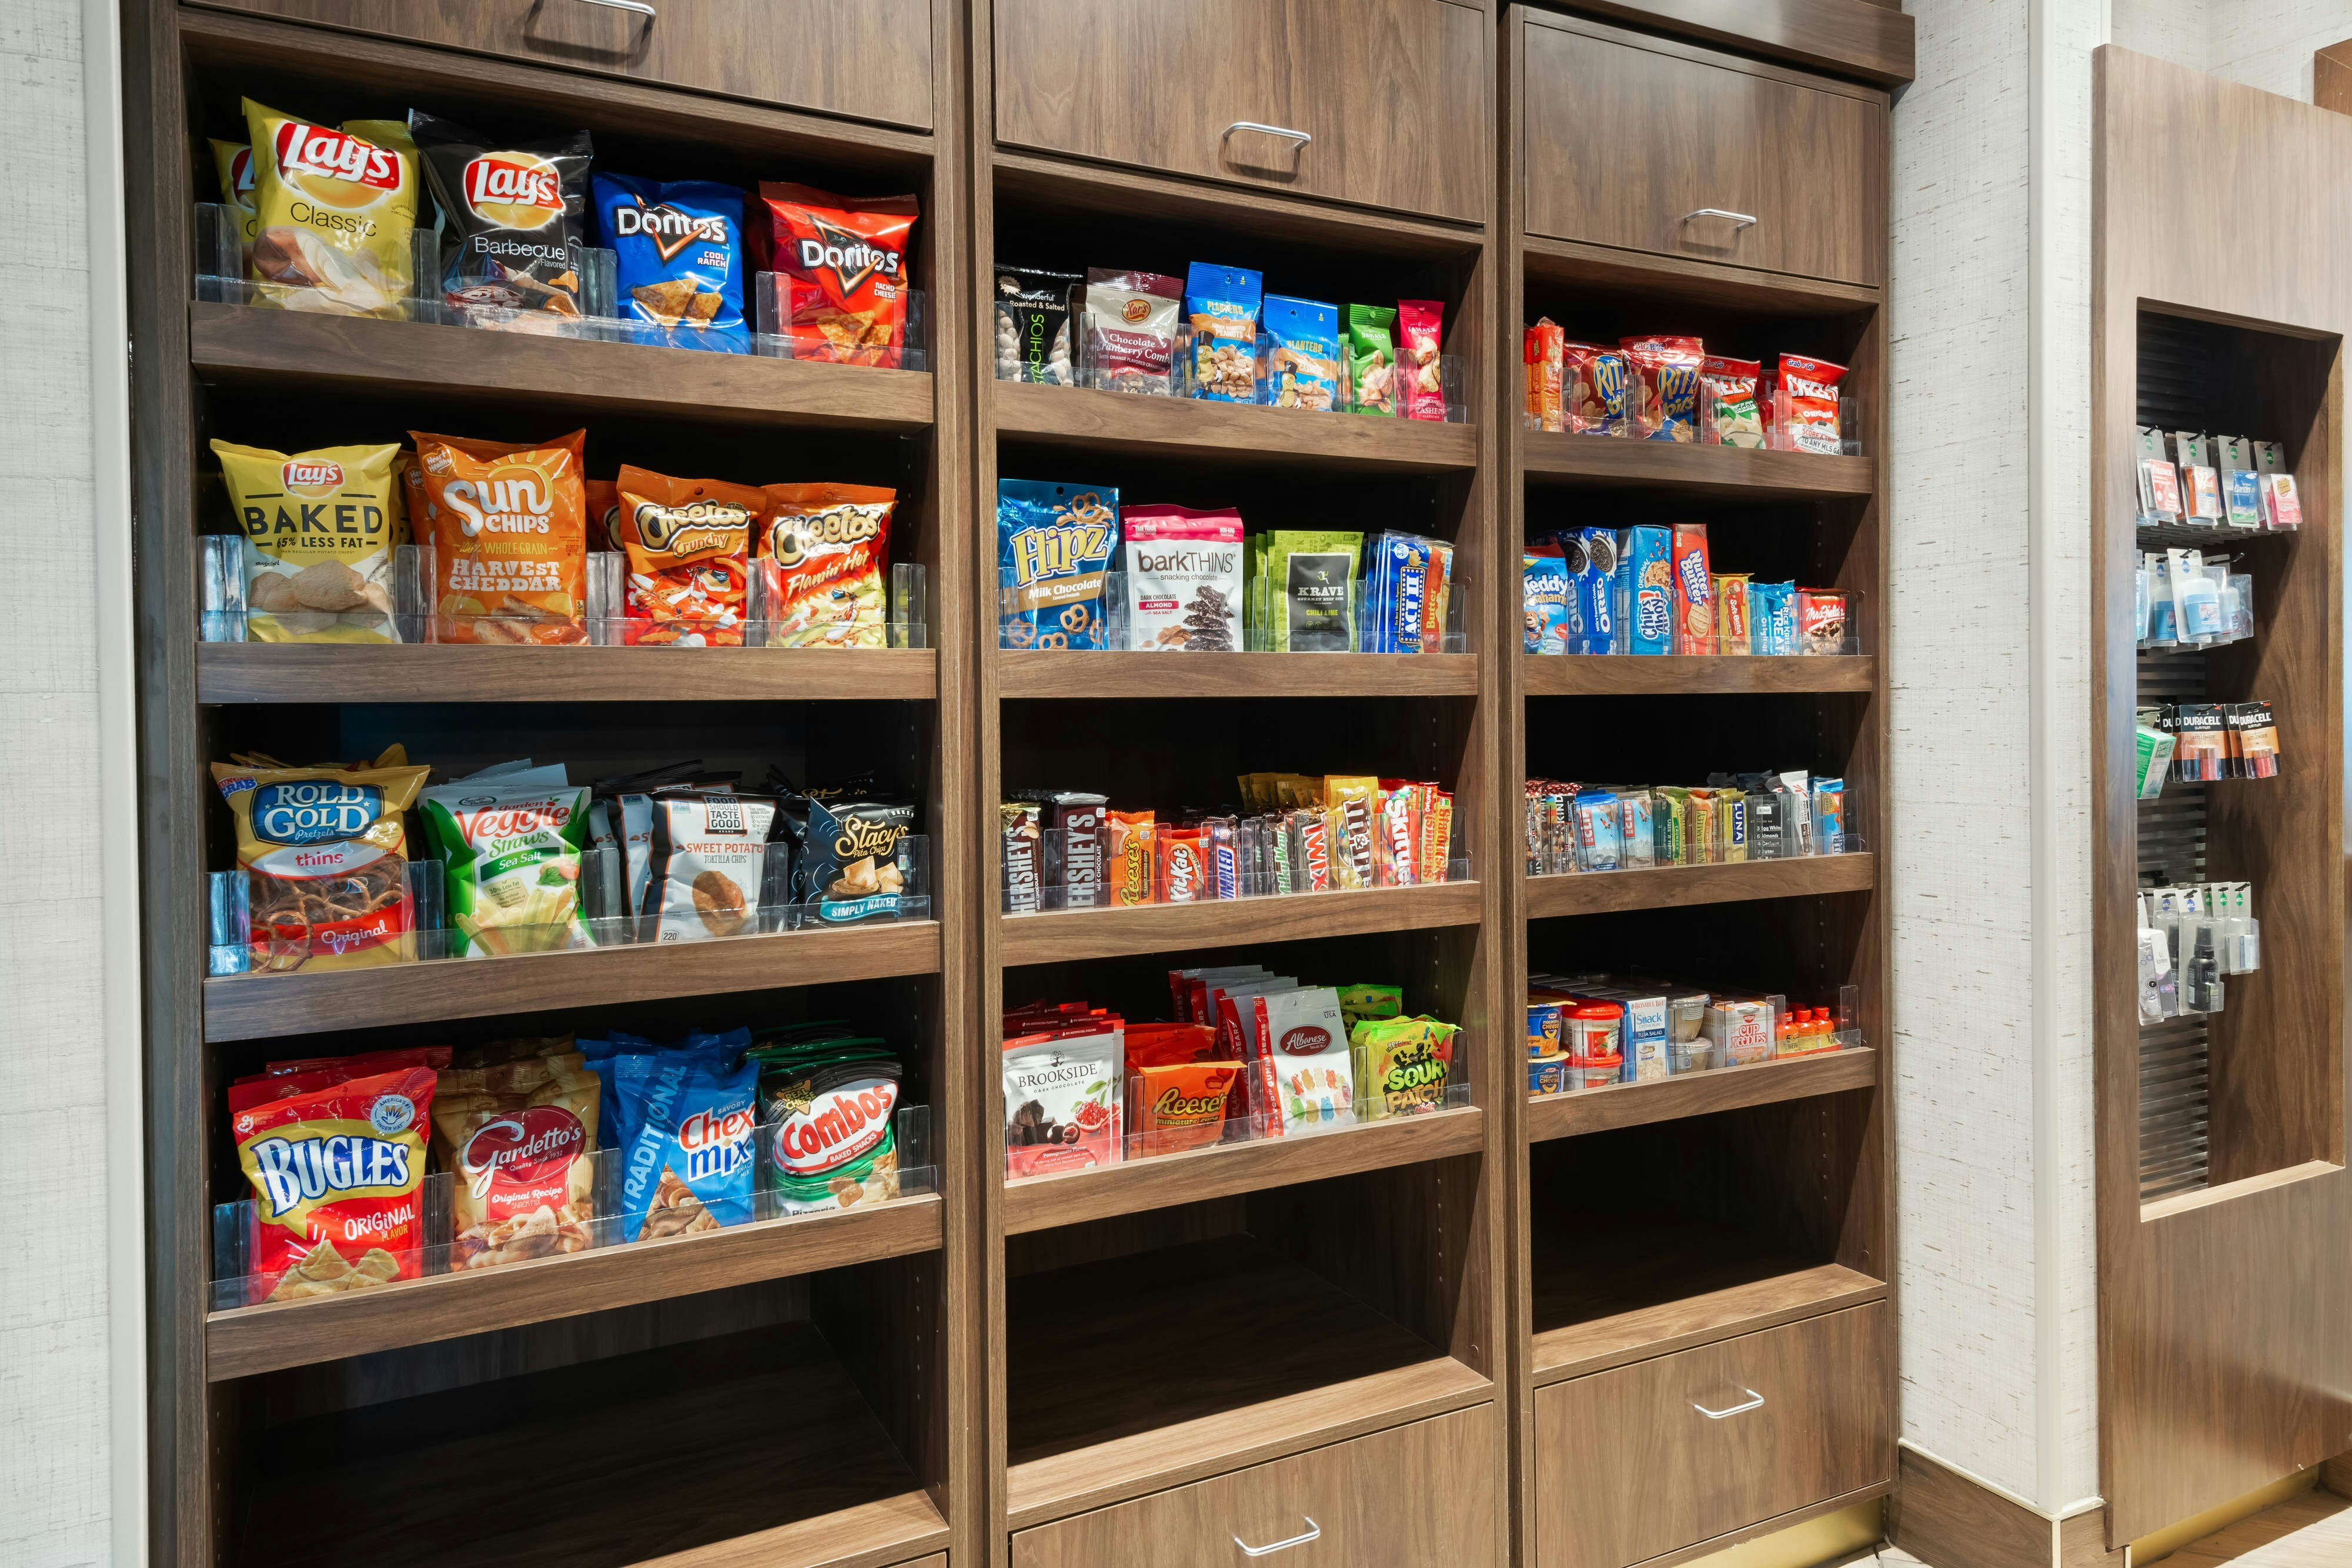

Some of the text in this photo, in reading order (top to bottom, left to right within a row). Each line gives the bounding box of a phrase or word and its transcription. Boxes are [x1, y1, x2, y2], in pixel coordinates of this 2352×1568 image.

[281, 125, 395, 182] Lay's
[473, 161, 555, 205] Lay's
[291, 202, 377, 237] Classic
[617, 208, 727, 242] Doritos
[475, 237, 566, 261] Barbecue
[704, 250, 725, 260] COOL
[801, 240, 898, 273] Doritos
[540, 258, 566, 269] Flavored
[697, 257, 726, 268] RANCH
[874, 289, 896, 299] CHEESE
[875, 282, 896, 292] NACHO
[1021, 293, 1054, 301] Wonderful
[1010, 300, 1037, 309] Roasted
[1045, 302, 1065, 311] Salted
[1127, 302, 1148, 317] Kar's
[1207, 301, 1244, 315] PLANTERS
[1110, 333, 1155, 347] Chocolate
[1658, 366, 1699, 401] RITZ
[1663, 396, 1693, 416] bits
[427, 450, 447, 464] Heart
[288, 464, 339, 486] Lay's
[443, 480, 553, 537] Sun
[243, 504, 382, 536] BAKED
[485, 514, 549, 534] CHIPS
[639, 504, 747, 548] Cheetos
[277, 537, 363, 548] 65% LESS FAT
[673, 532, 729, 557] Crunchy
[776, 506, 881, 564] Cheetos
[459, 542, 547, 554] 100% WHOLE GRAIN
[1011, 525, 1110, 589] Flipz
[452, 559, 560, 576] HARVEST
[1138, 550, 1233, 573] barkTHINS
[449, 576, 562, 591] CHEDDAR
[787, 550, 870, 600] Flamin' Hot
[1638, 558, 1651, 589] ORIGINAL
[1679, 558, 1703, 606] Butter
[1689, 549, 1709, 600] Nutter
[1028, 579, 1101, 600] Milk Chocolate
[1298, 586, 1344, 596] KRAVE
[1524, 574, 1568, 595] Teddy
[1426, 588, 1436, 629] Butter
[1525, 592, 1566, 606] Grahams
[1597, 577, 1611, 634] OREO
[1642, 600, 1658, 639] Chips
[1733, 615, 1743, 635] Batch
[2183, 716, 2220, 726] DURACELL
[2240, 713, 2272, 726] DURACELL
[275, 785, 365, 807] ROLD
[265, 805, 370, 837] GOLD
[710, 811, 740, 819] TASTE
[711, 820, 740, 828] GOOD
[1581, 811, 1593, 838] CLIF
[1625, 801, 1633, 828] CLIF
[1734, 803, 1743, 841] LUNA
[295, 828, 334, 841] Pretzels
[455, 806, 570, 849] Veggie
[834, 817, 909, 856] Stacy's
[1696, 811, 1706, 864] NATURE VALLEY
[489, 831, 549, 858] Straws
[687, 843, 764, 853] SWEET POTATO
[853, 845, 886, 858] Pita Chips
[295, 851, 344, 867] thins
[499, 851, 541, 870] Sea Salt
[704, 855, 747, 864] TORTILLA CHIPS
[1119, 838, 1140, 907] Reese's
[831, 901, 864, 918] SIMPLY
[867, 897, 897, 910] NAKED
[322, 920, 388, 945] Original
[663, 932, 677, 941] 220
[1636, 1012, 1663, 1025] Snack
[1739, 1024, 1760, 1035] CUP
[1286, 1034, 1327, 1051] Albanese
[1730, 1033, 1767, 1049] NOODLES
[1018, 1064, 1097, 1088] BROOKSIDE
[1263, 1056, 1275, 1087] GUMMI
[1389, 1059, 1444, 1091] SOUR
[785, 1089, 808, 1101] REAL
[1051, 1080, 1085, 1090] CHOCOLATE
[1385, 1078, 1446, 1112] PATCH
[717, 1099, 746, 1115] SAVORY
[785, 1091, 817, 1111] CHEESE
[1153, 1088, 1227, 1115] Reese's
[375, 1119, 405, 1131] FINGER HAT
[680, 1103, 756, 1150] Chex
[781, 1085, 892, 1159] Combos
[623, 1066, 687, 1210] TRADITIONAL
[830, 1132, 878, 1164] BAKED SNACKS
[462, 1121, 582, 1199] Gardetto's
[509, 1150, 563, 1172] Quality Since 1932
[689, 1139, 750, 1179] mix
[1043, 1149, 1073, 1158] Pomegranate
[250, 1136, 410, 1218] BUGLES
[492, 1186, 563, 1205] Original Recipe
[382, 1224, 408, 1242] FLAVOR
